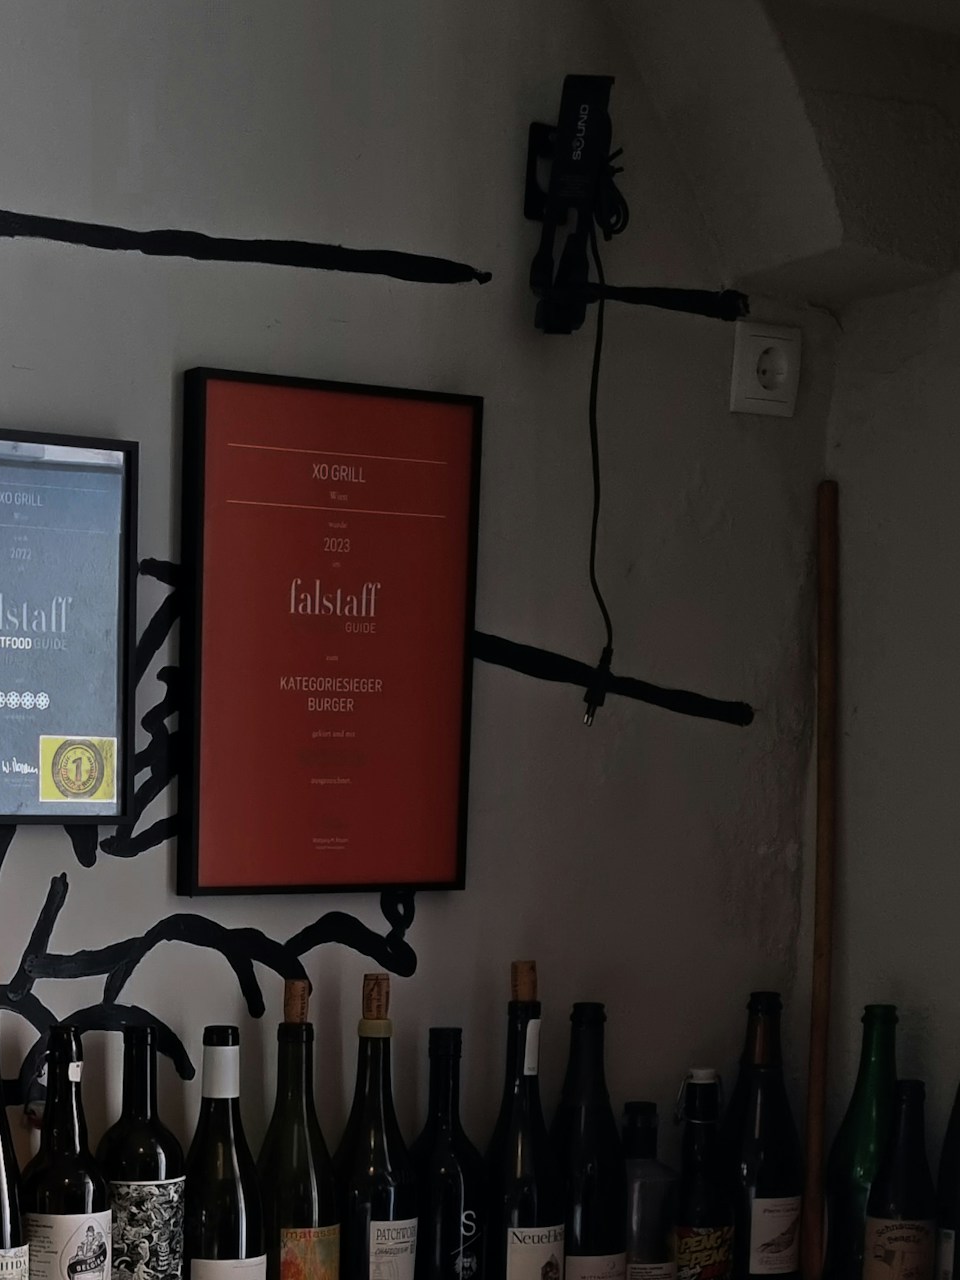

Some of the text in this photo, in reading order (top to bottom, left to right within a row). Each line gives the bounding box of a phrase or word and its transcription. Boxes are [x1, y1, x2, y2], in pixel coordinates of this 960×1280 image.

[571, 104, 589, 160] SOUND
[312, 463, 366, 483] XO GRILL
[0, 491, 44, 507] XO GRILL
[323, 537, 351, 553] 2023
[289, 577, 381, 617] falstaff
[344, 622, 377, 633] GUIDE
[33, 638, 68, 650] GUIDE
[279, 677, 383, 693] KATEGORIESIEGER
[307, 697, 354, 712] BURGER
[461, 1210, 476, 1236] S
